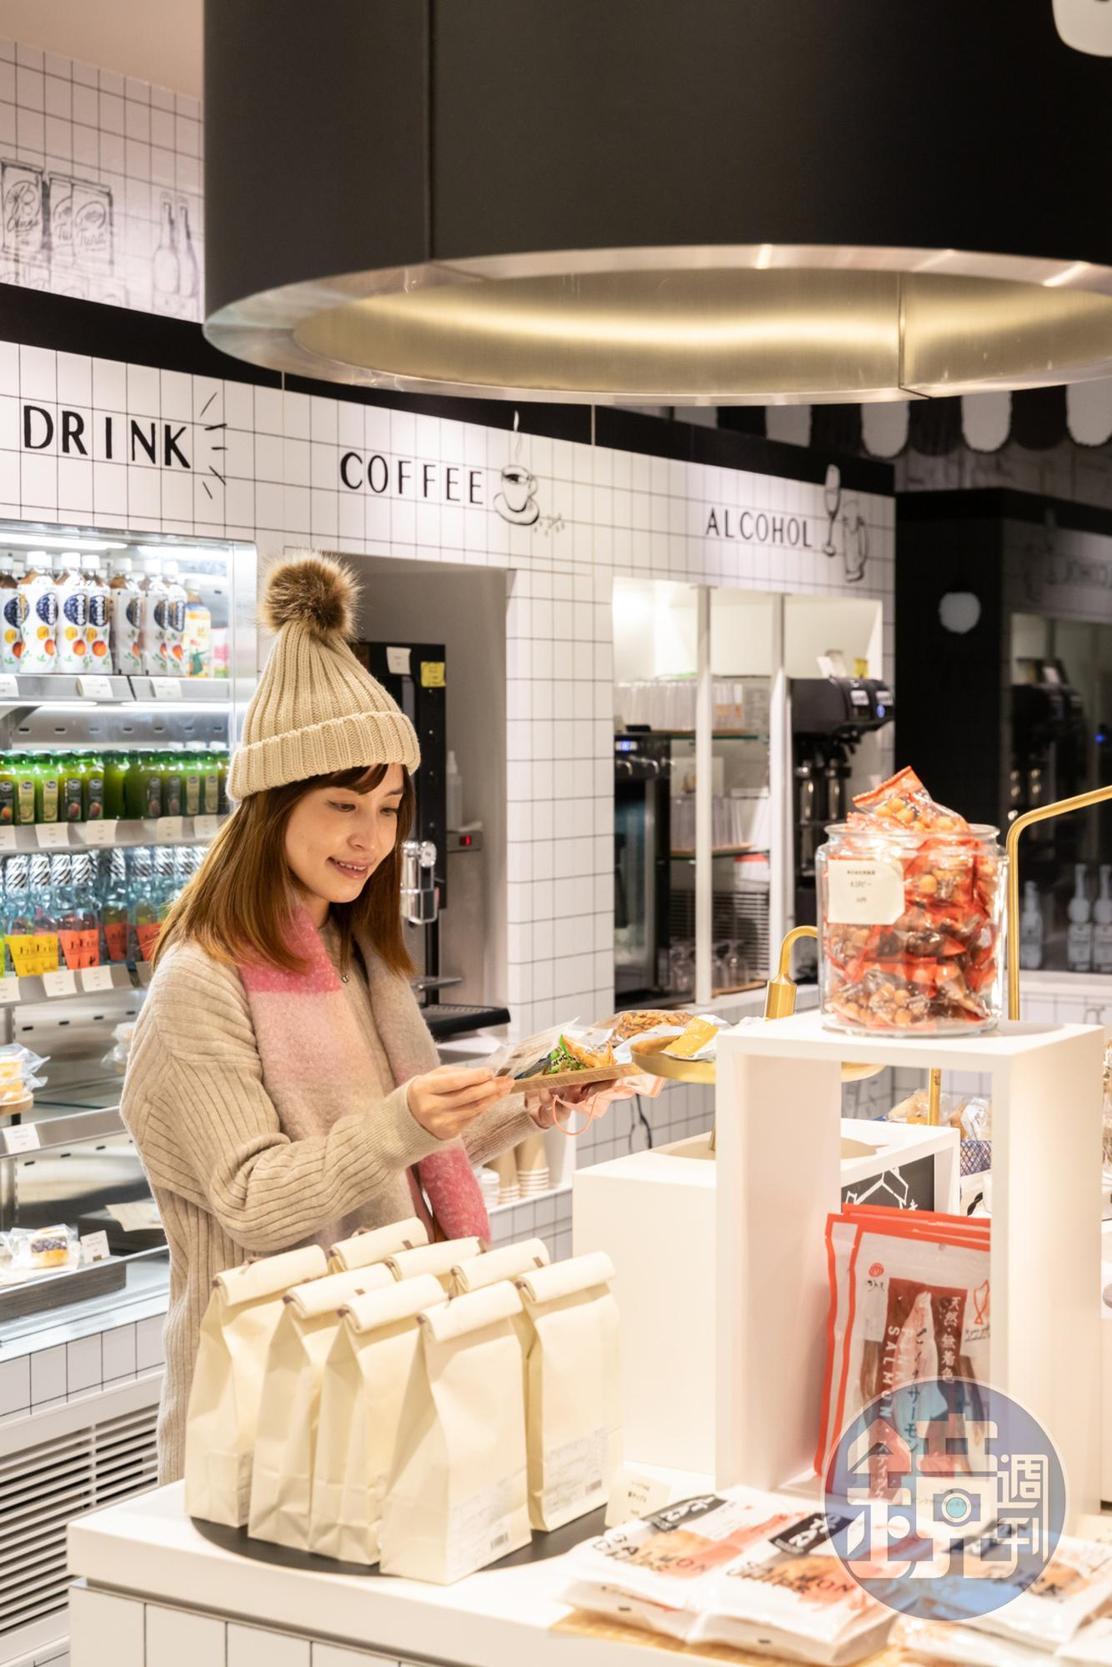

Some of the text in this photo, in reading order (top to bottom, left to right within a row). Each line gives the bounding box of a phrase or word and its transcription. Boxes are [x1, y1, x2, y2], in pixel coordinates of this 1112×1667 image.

[23, 405, 191, 469] DRINK
[340, 451, 484, 505] COFFEE
[705, 507, 812, 548] ALCOHOL
[879, 1325, 900, 1418] SALMON
